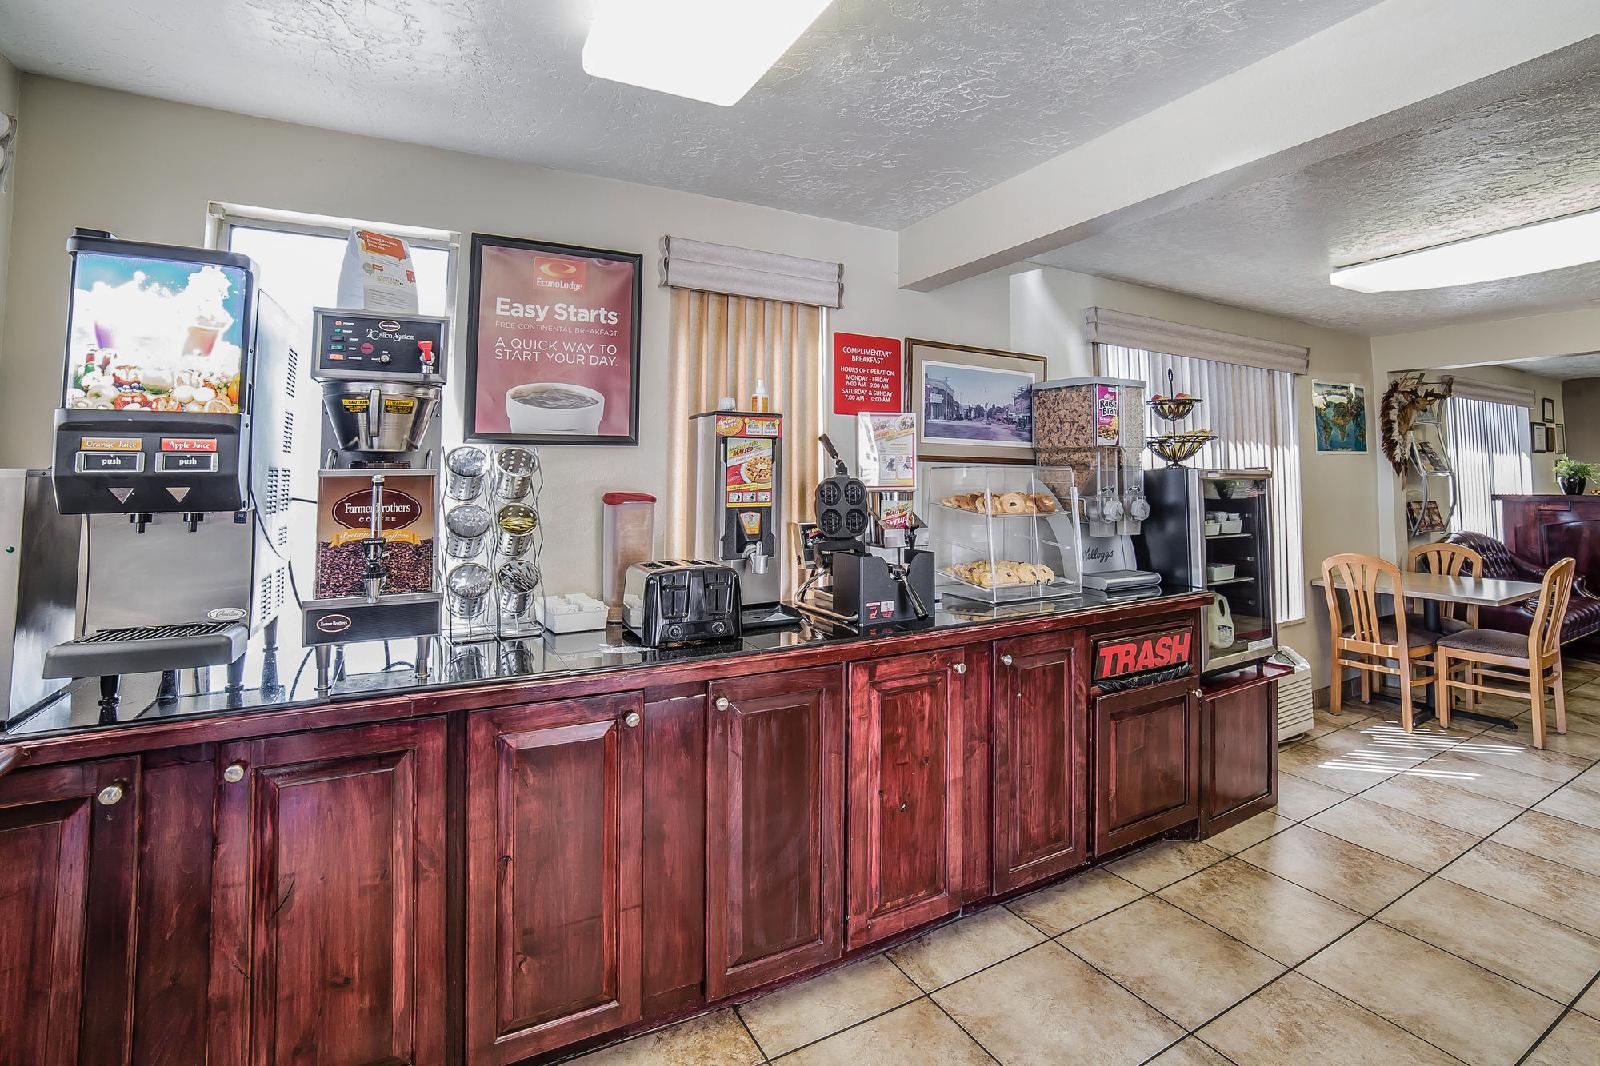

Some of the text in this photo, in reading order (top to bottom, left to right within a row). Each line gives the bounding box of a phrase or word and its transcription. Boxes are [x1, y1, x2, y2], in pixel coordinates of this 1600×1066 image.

[495, 297, 618, 325] Easy Starts
[495, 320, 516, 329] FREE
[518, 323, 572, 334] CONTINENTAL
[495, 337, 617, 355] A QUICK WAY TO
[842, 346, 893, 358] COMPLIMENTARY
[495, 348, 618, 367] START YOUR DAY.
[851, 355, 884, 364] BREAKFAST
[840, 366, 858, 374] HOURS
[845, 374, 868, 382] MONDAY
[873, 390, 893, 398] SUNDAY
[85, 440, 137, 449] Orange Juice
[168, 440, 210, 450] Apple Juice
[101, 458, 122, 466] push
[178, 458, 198, 466] push
[344, 502, 372, 514] Farme
[1099, 632, 1191, 678] TRASH
